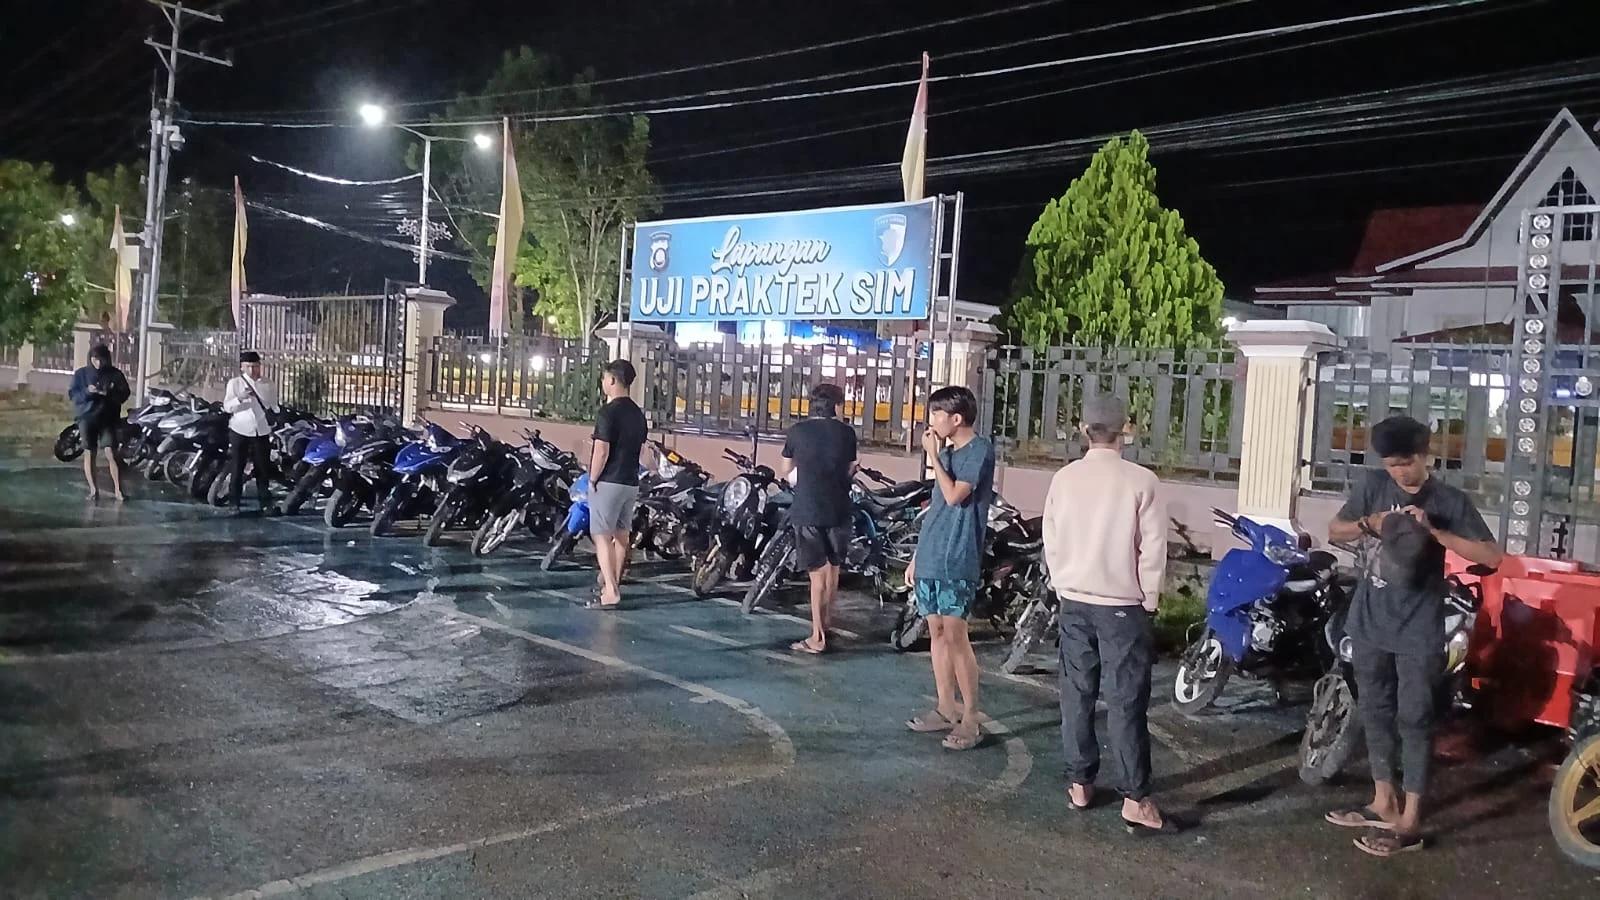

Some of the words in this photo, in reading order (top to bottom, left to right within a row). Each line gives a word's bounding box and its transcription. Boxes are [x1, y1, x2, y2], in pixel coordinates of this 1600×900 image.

[711, 225, 832, 278] Lapangan
[639, 277, 683, 316] UJI
[688, 272, 844, 315] PRAKTEK
[850, 268, 914, 314] SIM
